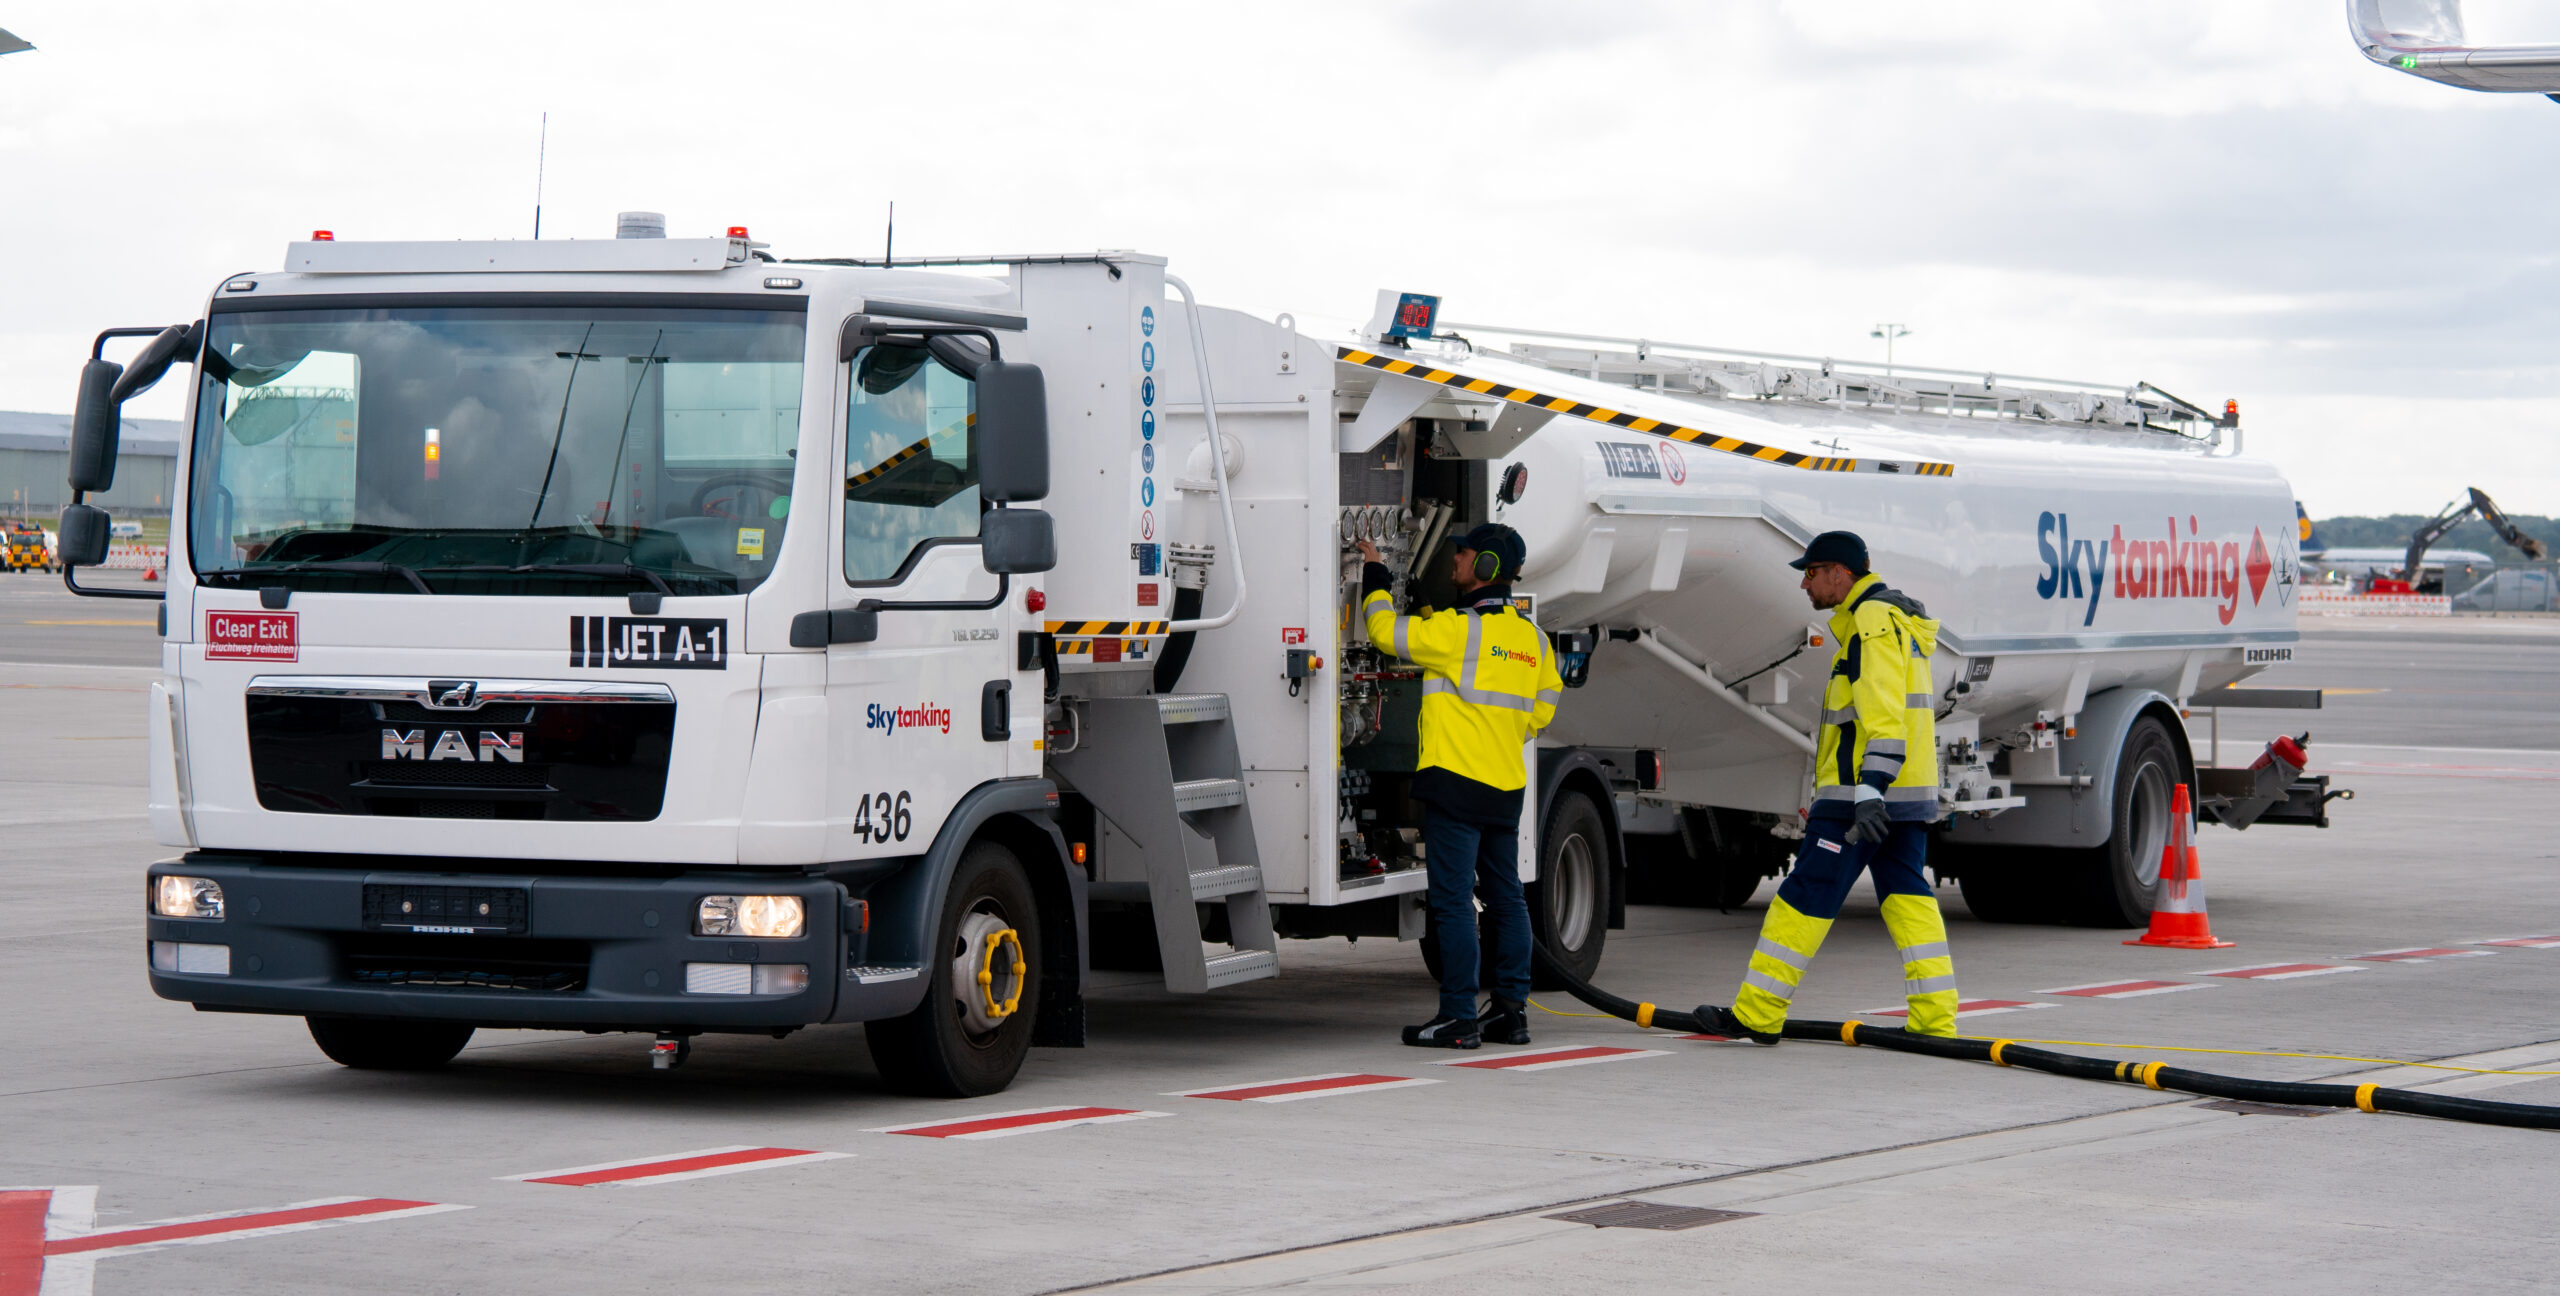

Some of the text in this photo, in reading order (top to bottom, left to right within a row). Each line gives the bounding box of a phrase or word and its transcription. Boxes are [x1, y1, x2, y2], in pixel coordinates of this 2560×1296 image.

[1617, 447, 1659, 473] JET A-1
[2036, 511, 2240, 627] Skytanking
[215, 618, 289, 639] Clear Exit
[210, 641, 294, 655] Fluchtweg freihalten
[613, 624, 721, 662] JET A-1
[2247, 648, 2292, 662] ROHR
[1491, 645, 1536, 668] Skytanking
[866, 701, 950, 736] Skytanking
[382, 728, 524, 763] MAN
[853, 790, 912, 844] 436
[412, 925, 475, 934] ROHR
